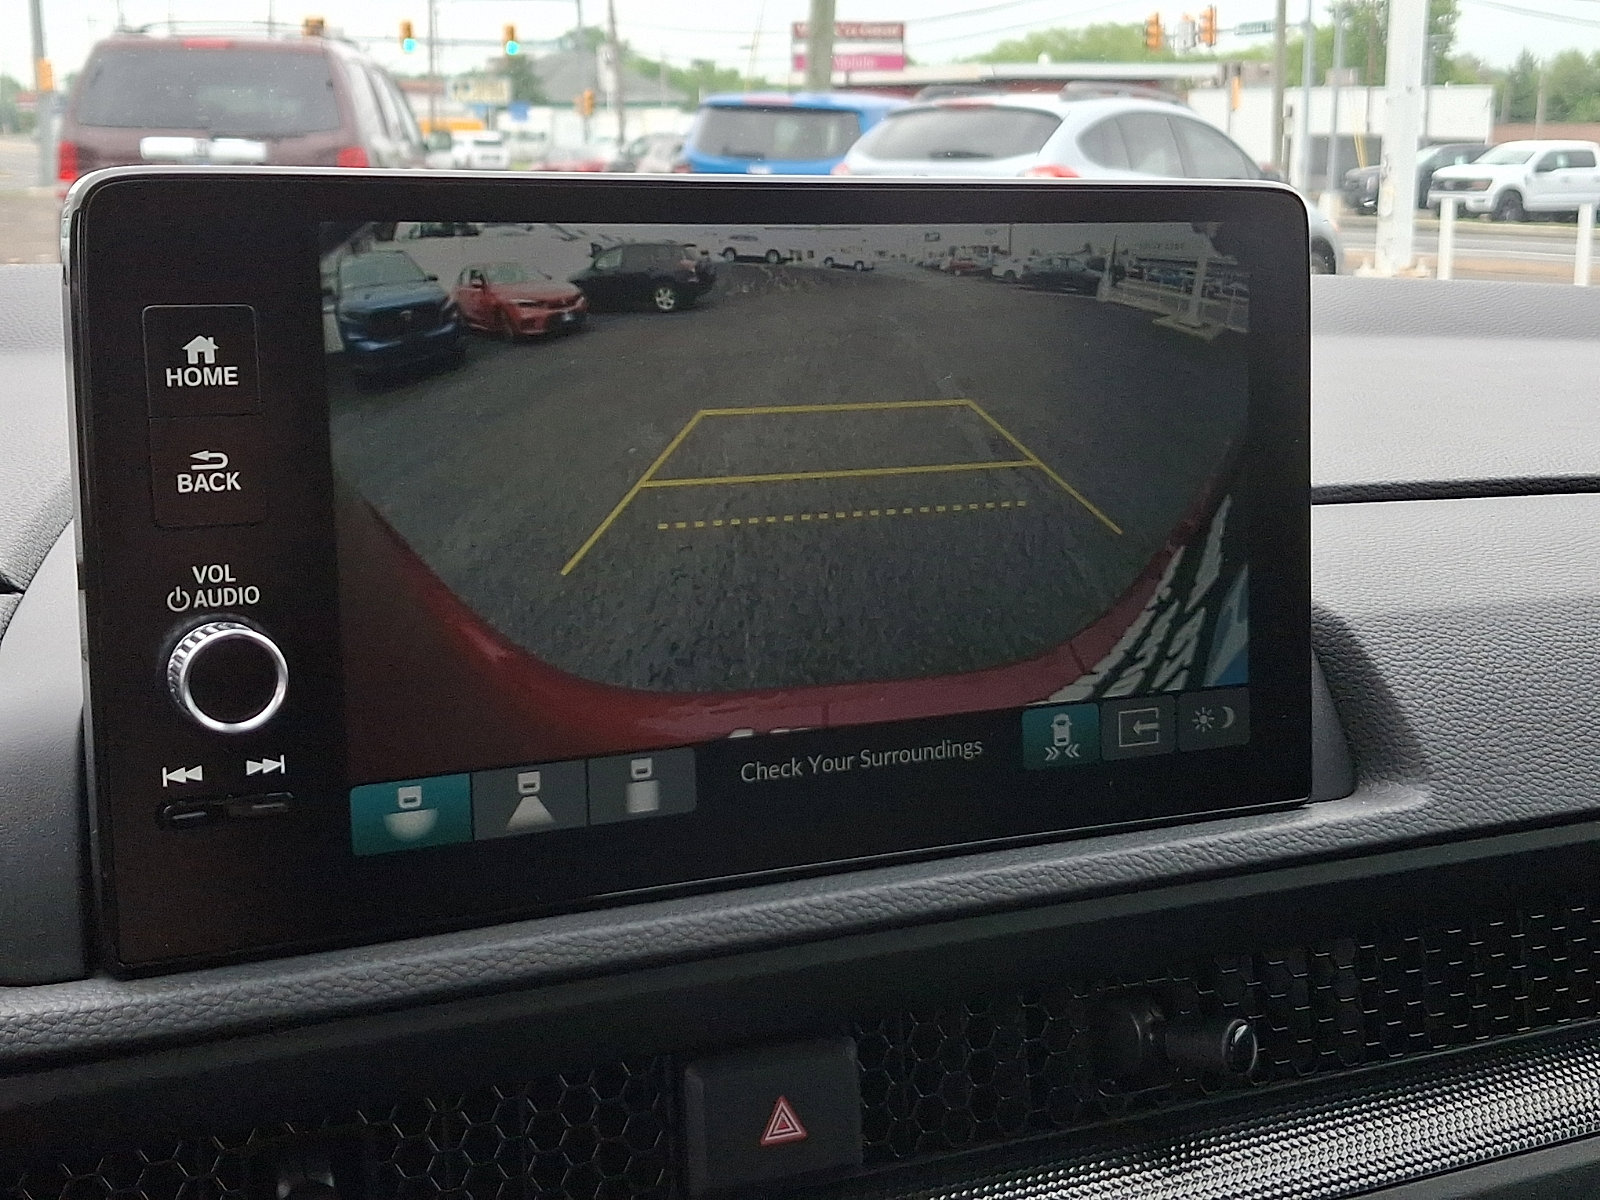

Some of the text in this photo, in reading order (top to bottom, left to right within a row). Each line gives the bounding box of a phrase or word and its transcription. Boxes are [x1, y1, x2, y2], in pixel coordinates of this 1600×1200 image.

[165, 366, 239, 387] HOME
[177, 471, 241, 493] BACK
[192, 564, 236, 584] VOL
[193, 585, 260, 608] AUDIO
[740, 739, 983, 782] Check Your Surroundings
